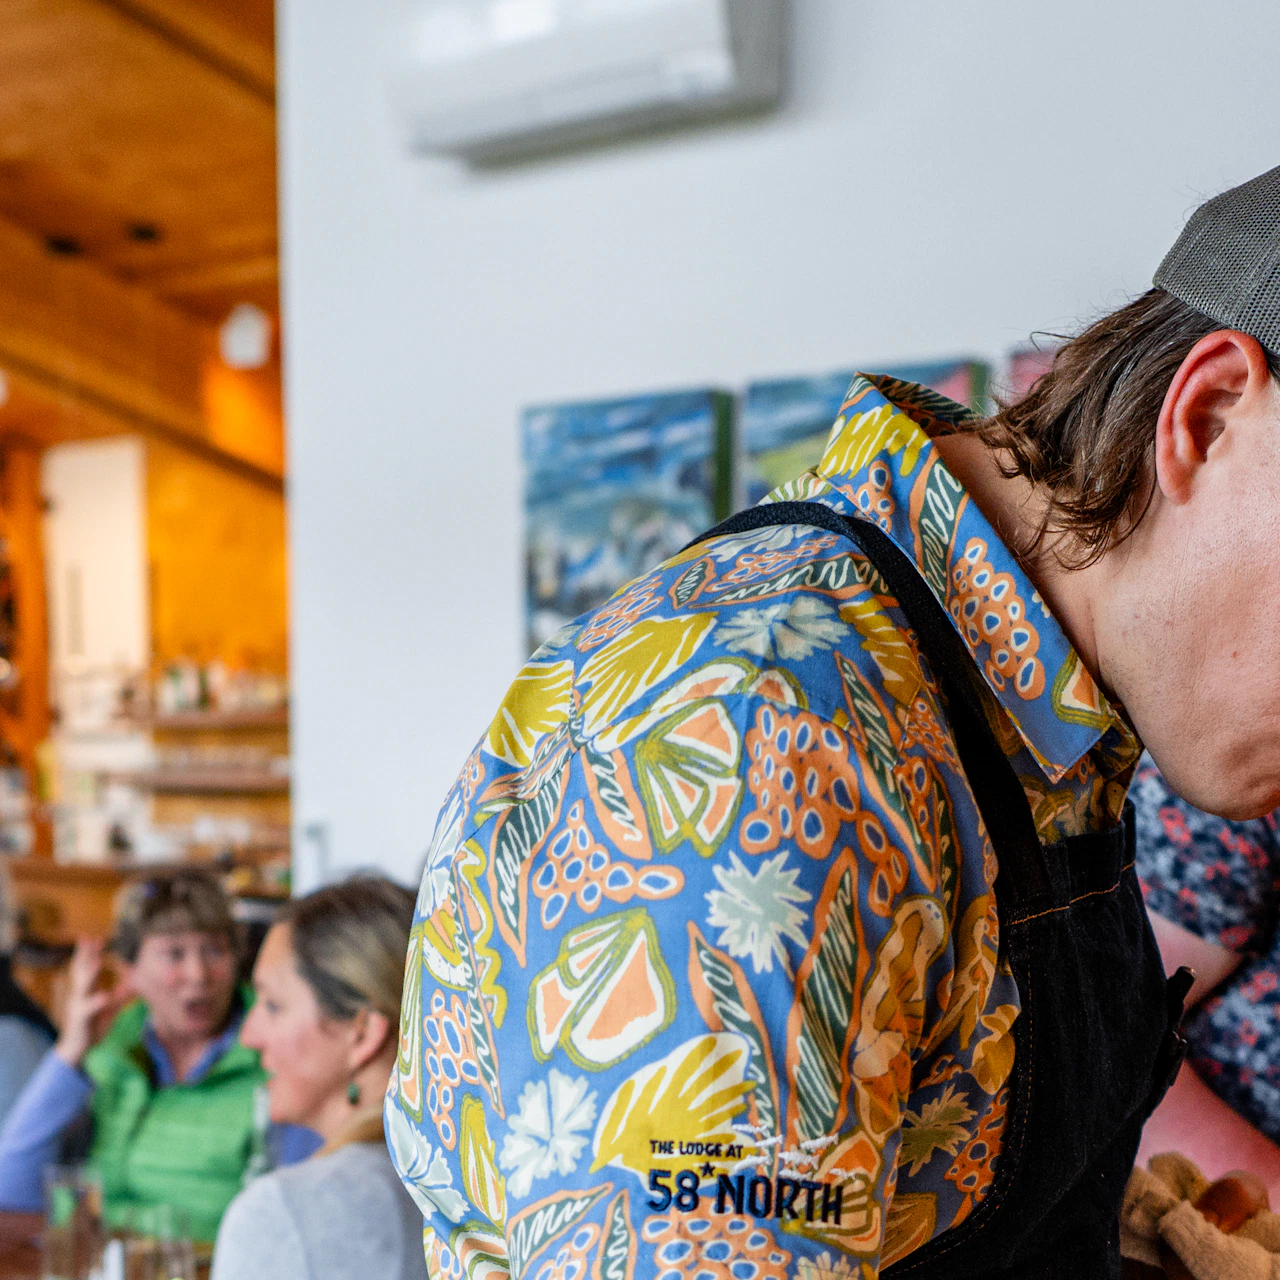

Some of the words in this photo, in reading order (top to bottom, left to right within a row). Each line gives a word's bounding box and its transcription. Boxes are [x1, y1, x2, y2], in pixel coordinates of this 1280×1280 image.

[649, 1139, 674, 1154] THE
[679, 1141, 723, 1157] LODGE
[725, 1144, 744, 1159] AT
[648, 1169, 700, 1213] 58
[716, 1174, 844, 1225] NORTH
